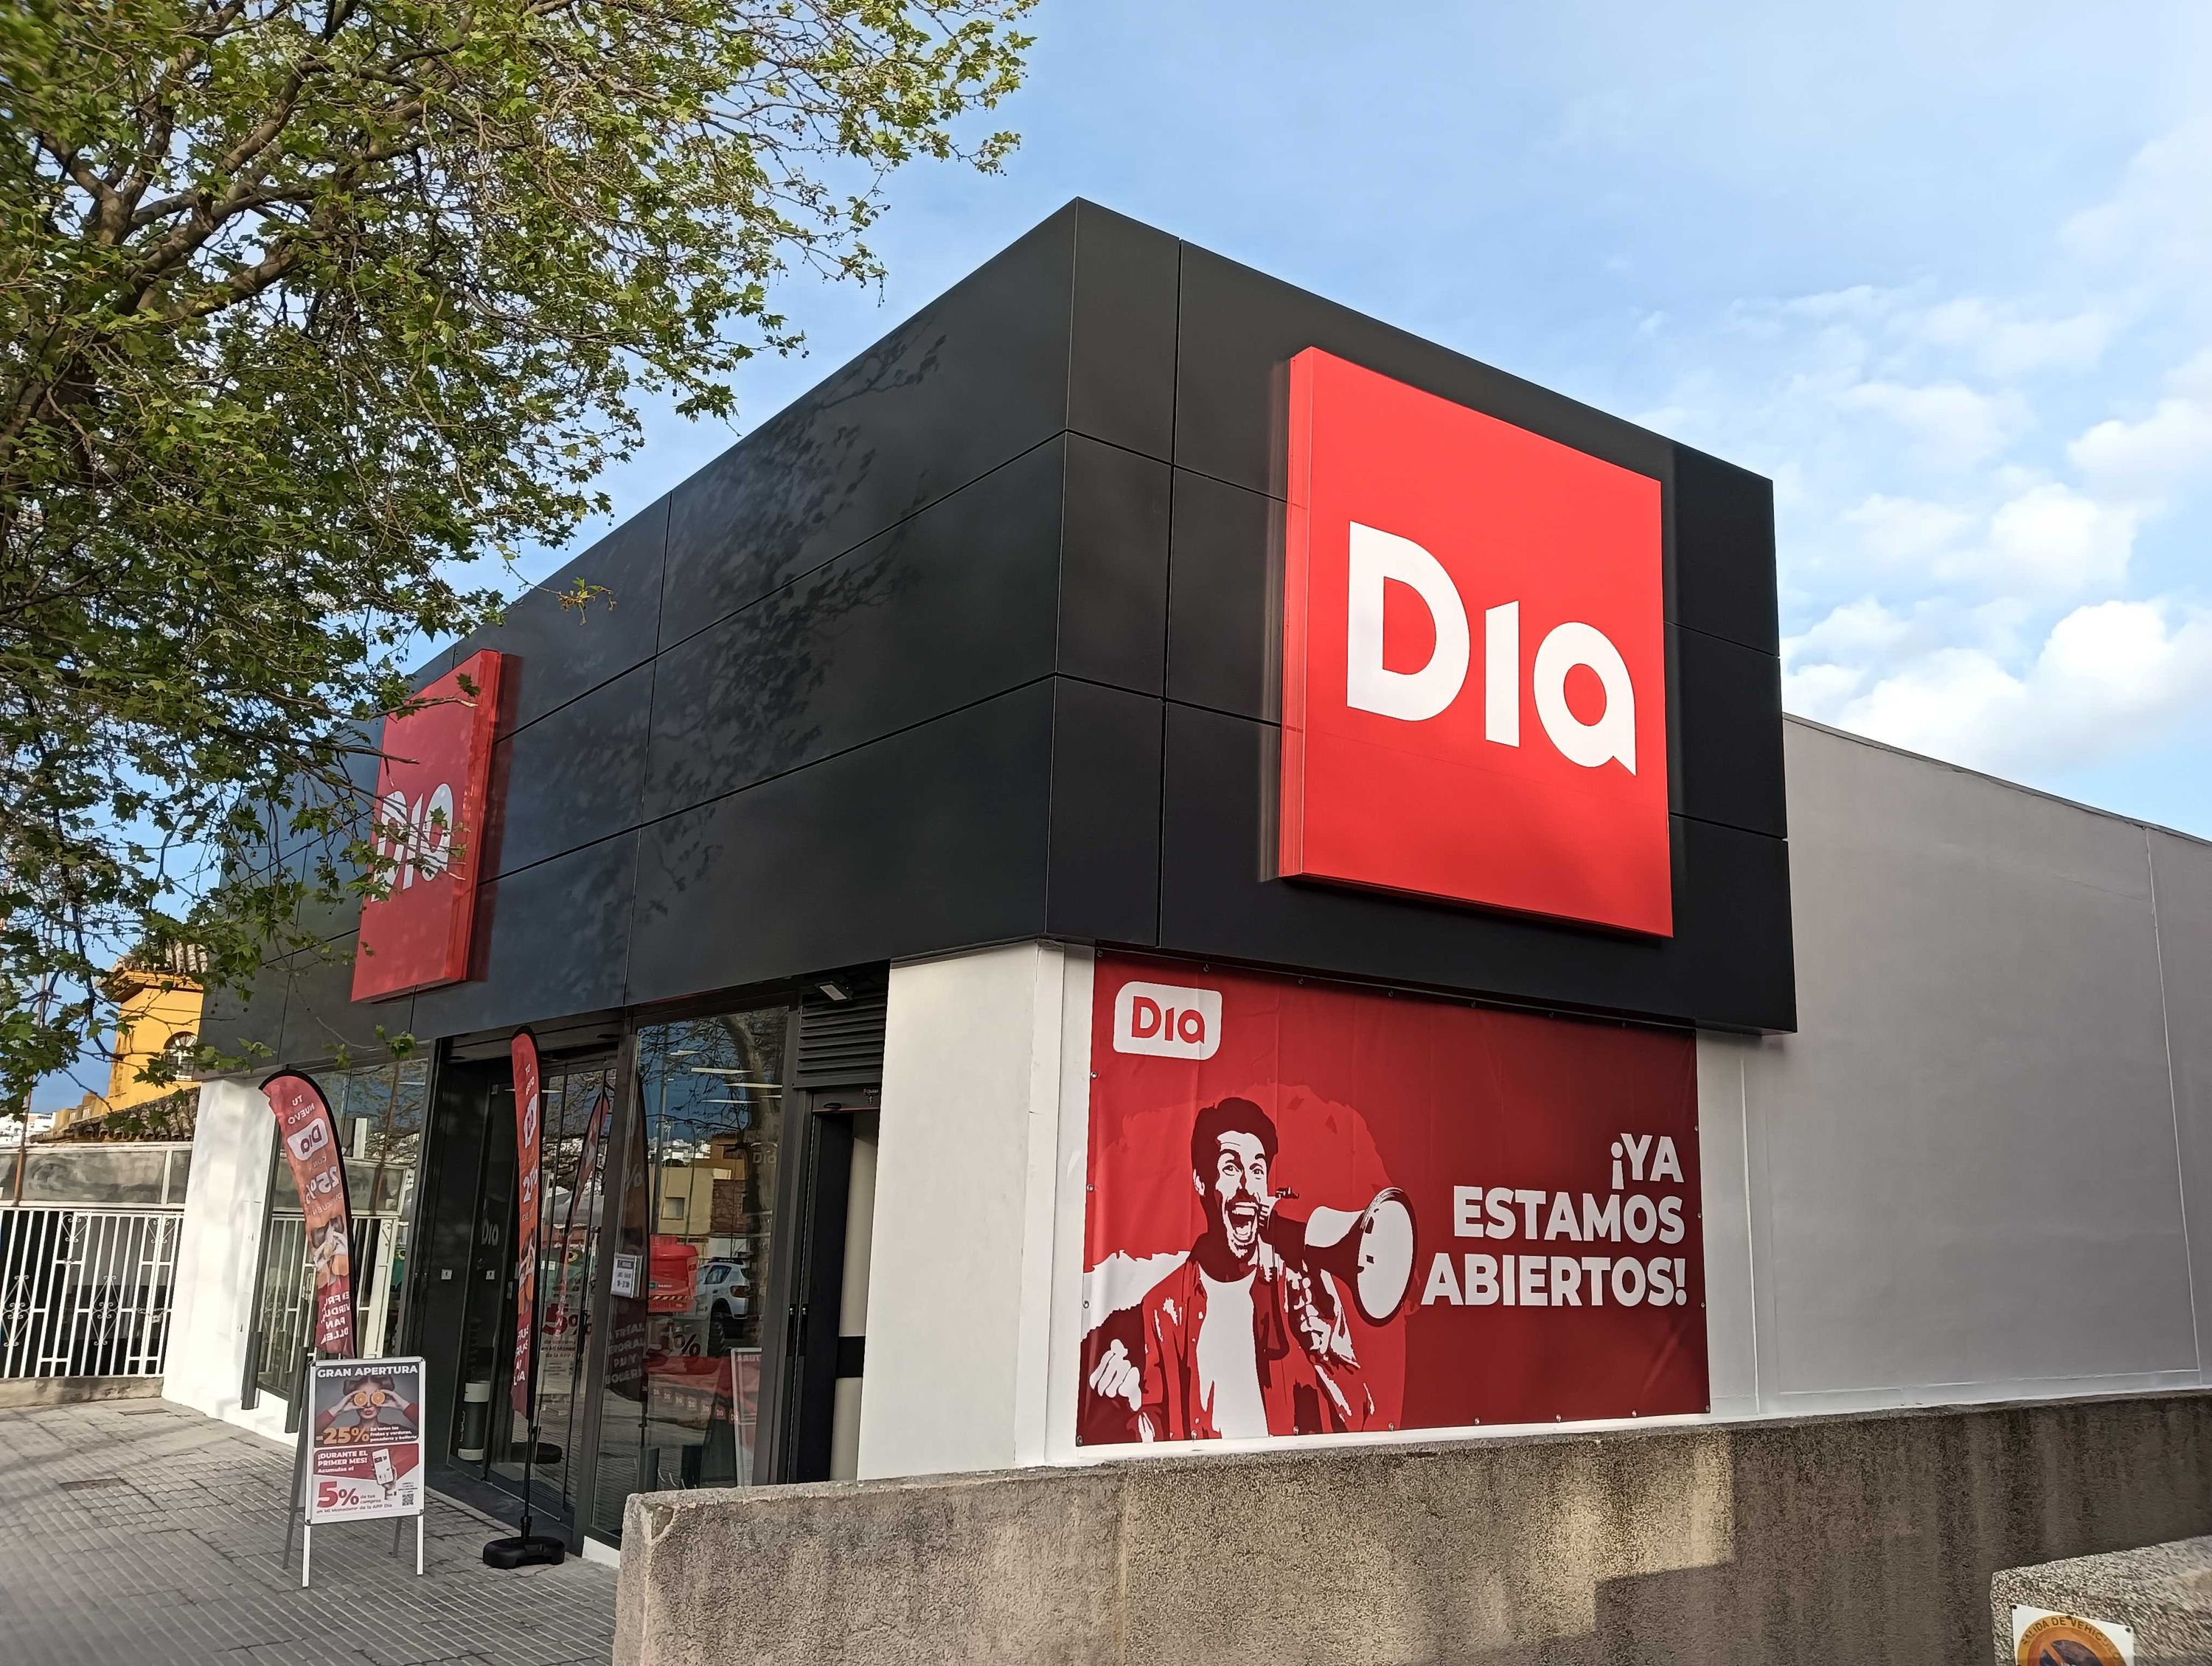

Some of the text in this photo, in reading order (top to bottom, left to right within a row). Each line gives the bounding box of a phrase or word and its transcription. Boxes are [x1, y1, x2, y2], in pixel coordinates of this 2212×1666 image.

[1610, 1133, 1685, 1190] ¡YA
[1453, 1185, 1686, 1245] ESTAMOS
[1421, 1252, 1688, 1307] ABIERTOS!
[317, 1365, 418, 1378] GRAN APERTURA
[316, 1426, 369, 1445] -25%
[318, 1451, 358, 1460] ¡DURANTE
[316, 1481, 360, 1508] 5%
[2021, 1620, 2050, 1645] SALIDA
[2051, 1617, 2067, 1626] DE
